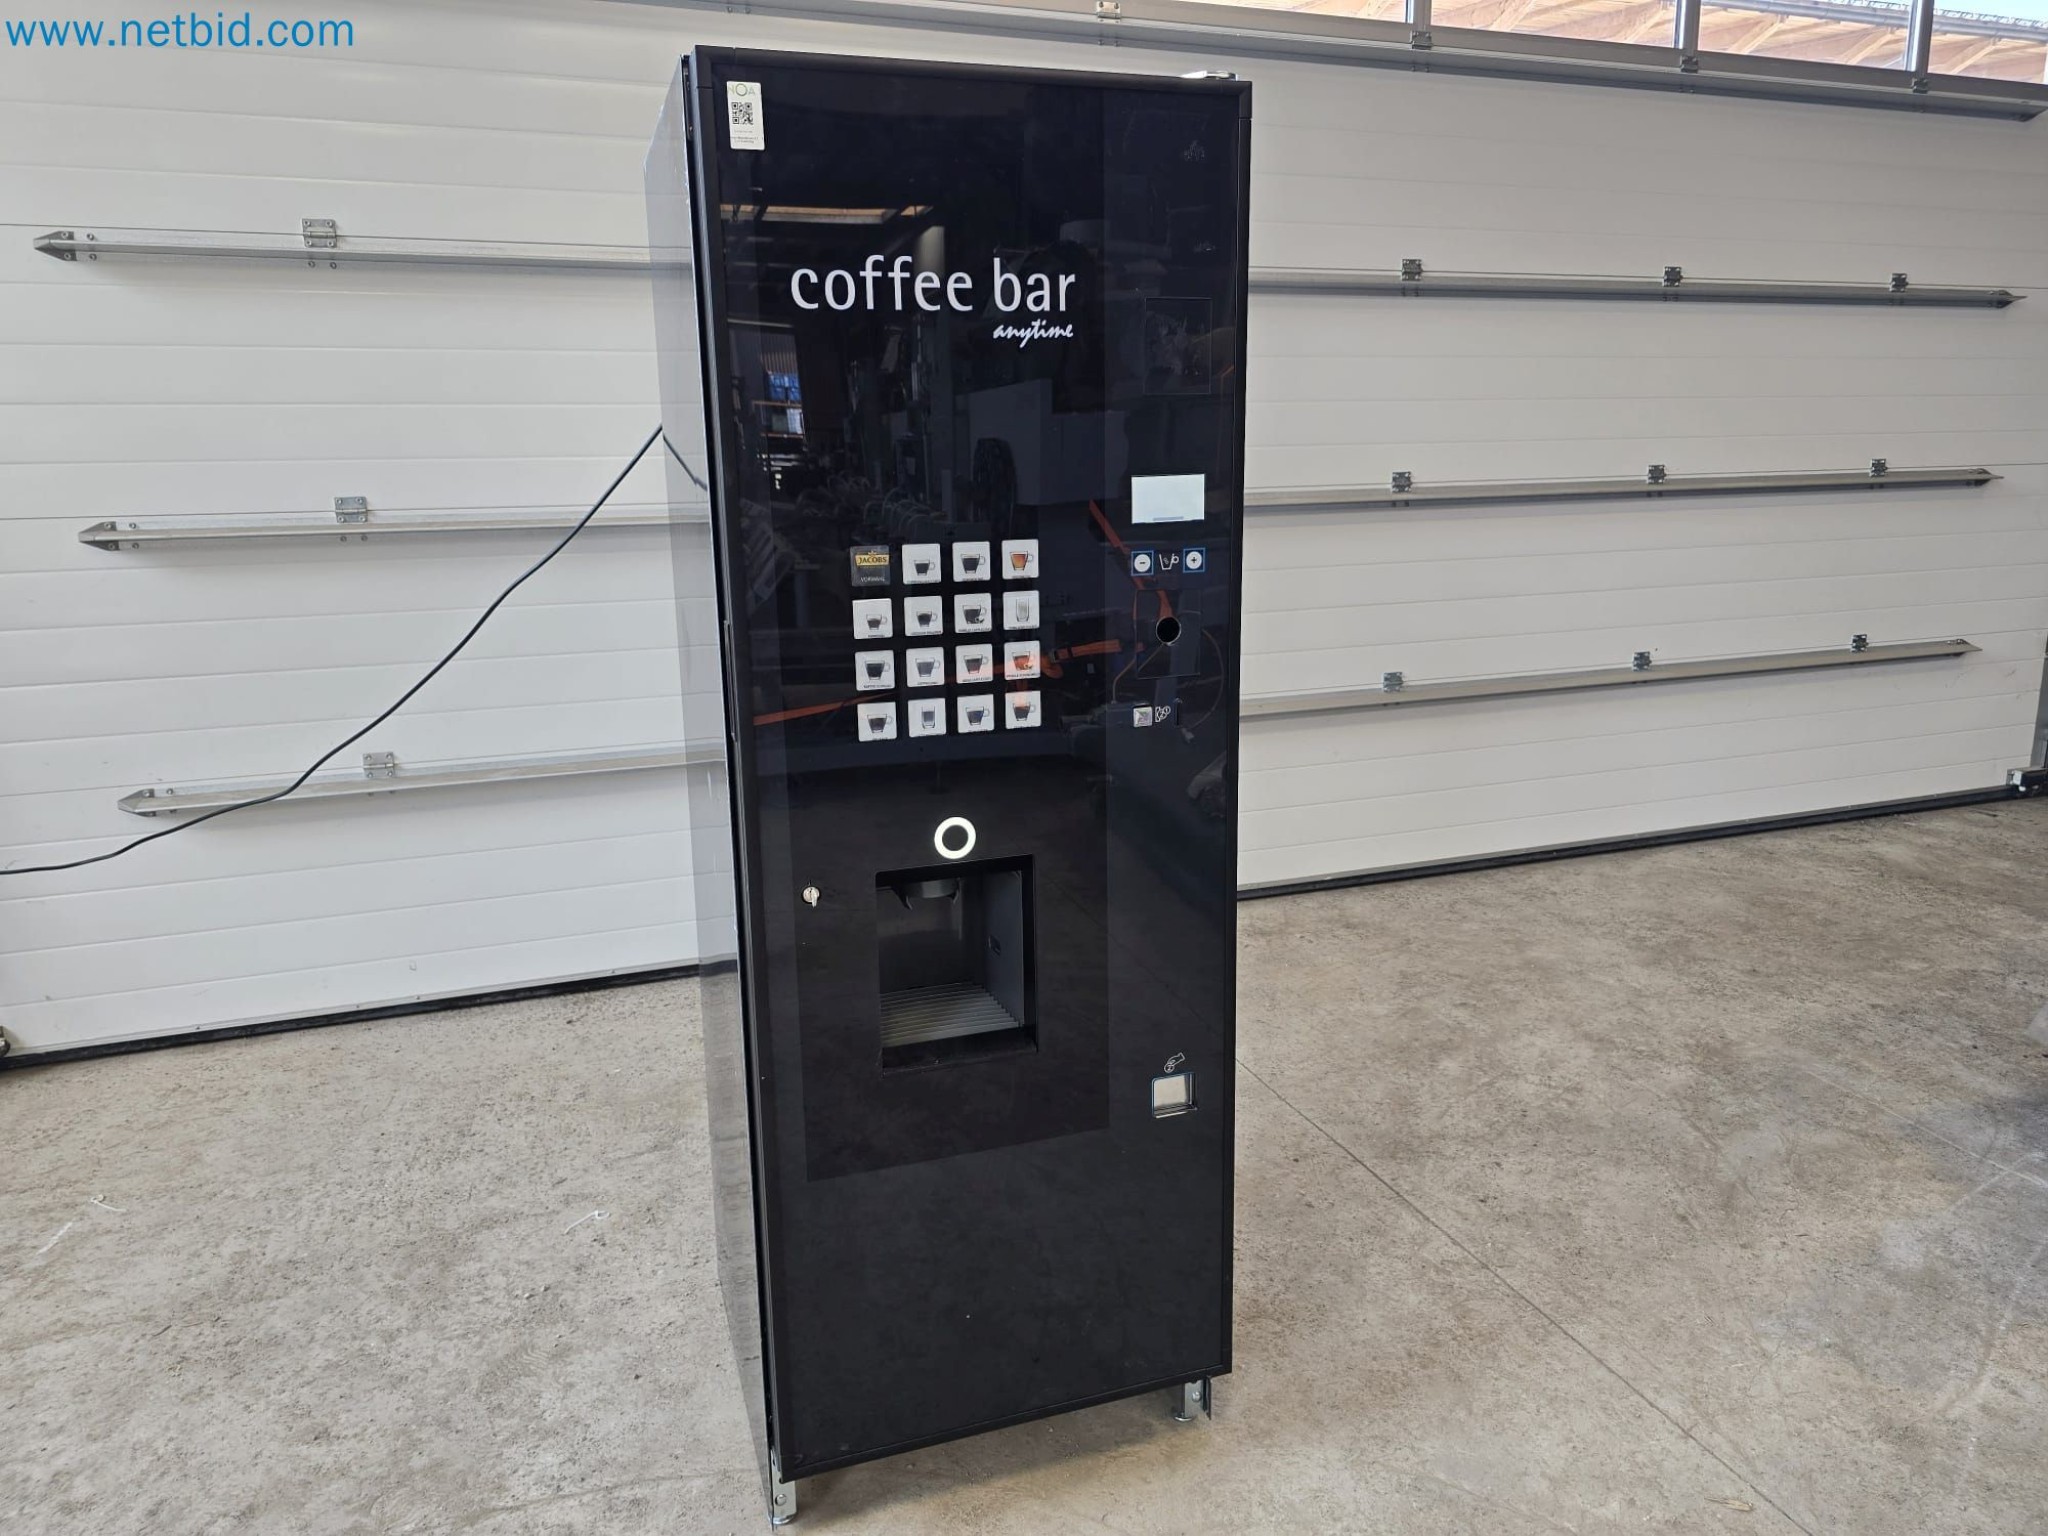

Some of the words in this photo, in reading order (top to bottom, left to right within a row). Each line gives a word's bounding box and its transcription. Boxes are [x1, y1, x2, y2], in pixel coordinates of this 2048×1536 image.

[790, 254, 973, 311] coffee
[993, 257, 1076, 312] bar
[992, 318, 1074, 349] anytime
[857, 556, 887, 565] JACOBS
